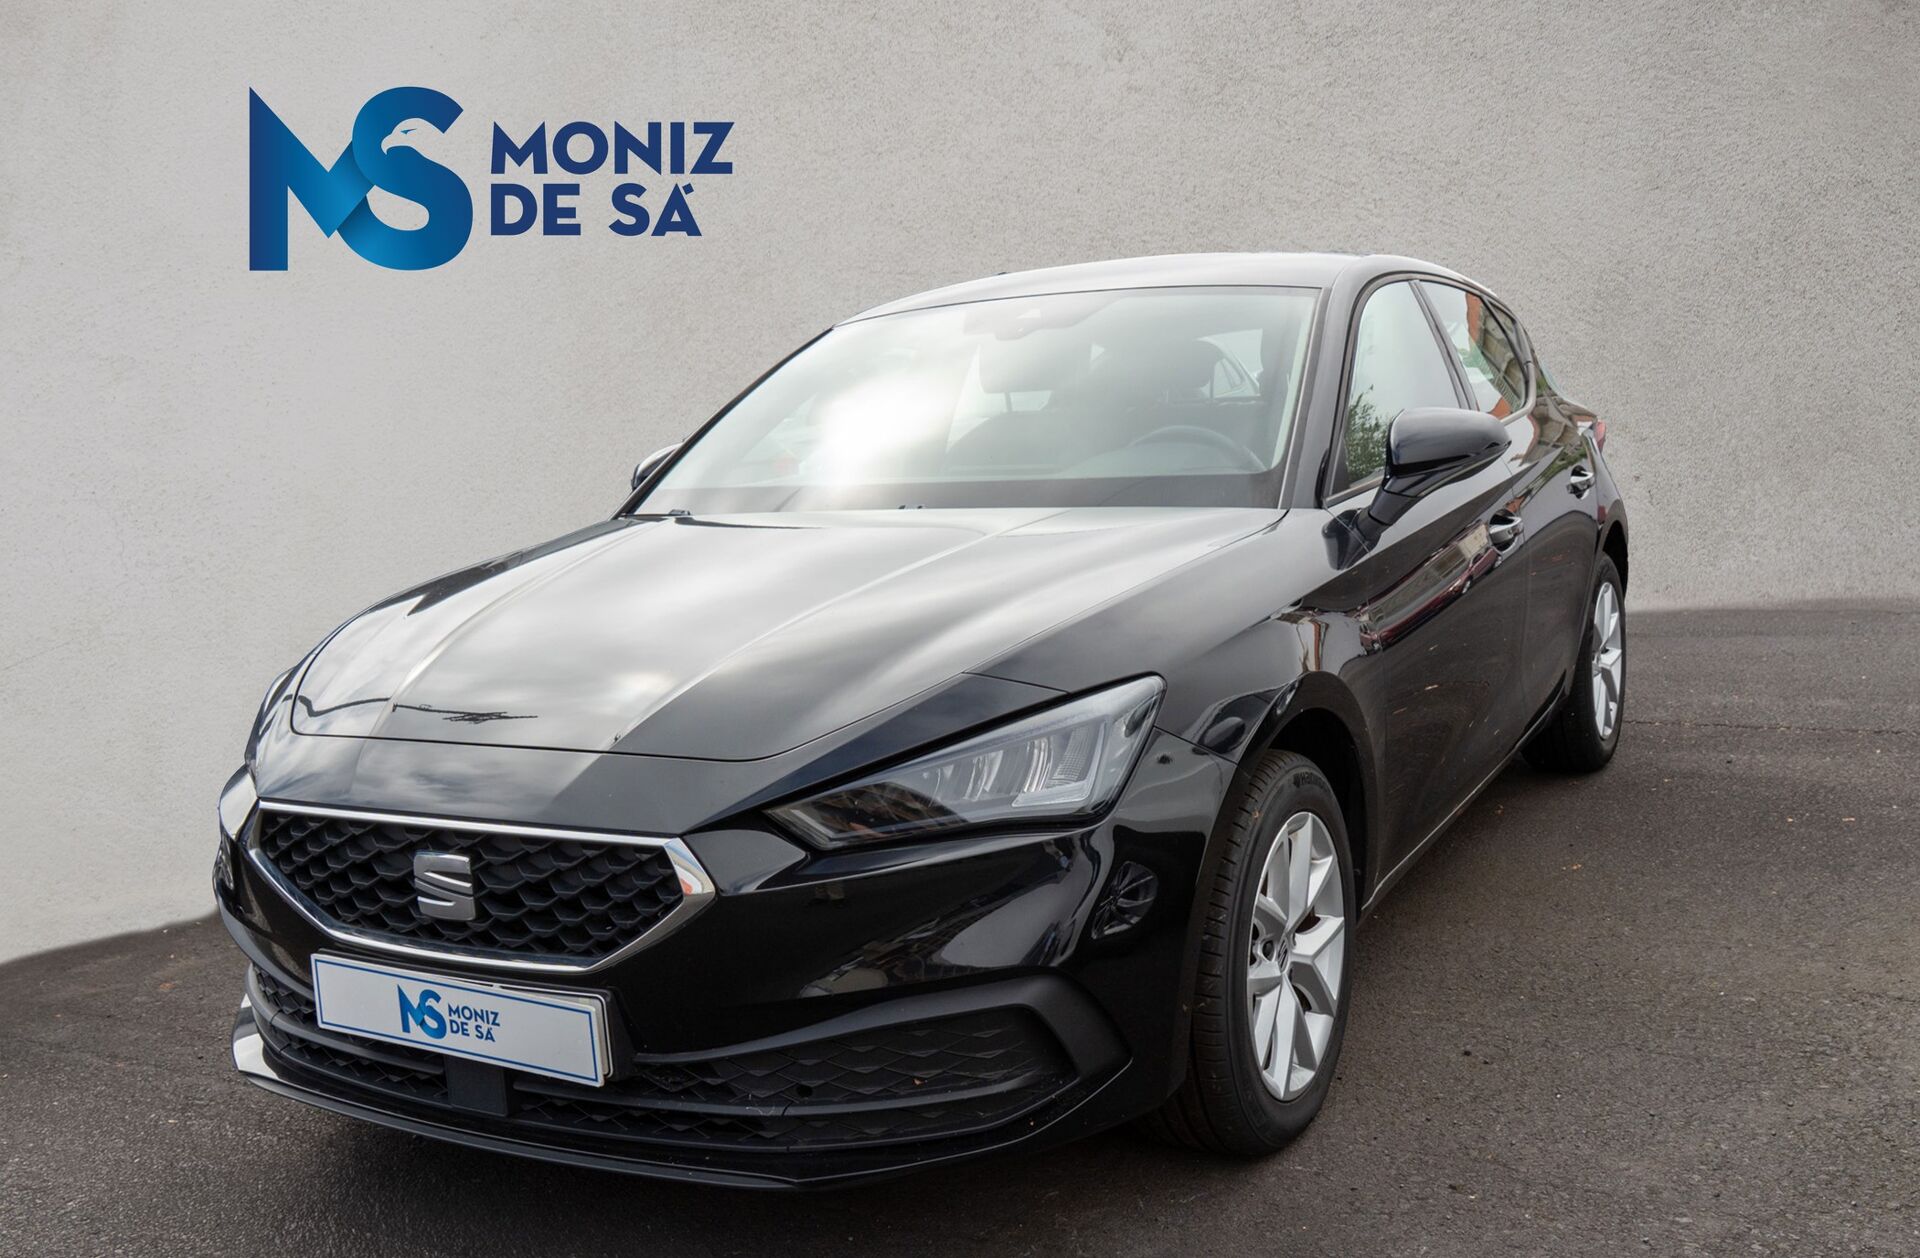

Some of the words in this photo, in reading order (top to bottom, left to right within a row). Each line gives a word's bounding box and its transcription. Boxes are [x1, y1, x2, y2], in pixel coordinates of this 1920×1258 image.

[447, 1003, 500, 1027] MONIZ
[449, 1020, 470, 1037] DE
[475, 1024, 496, 1043] SÁ
